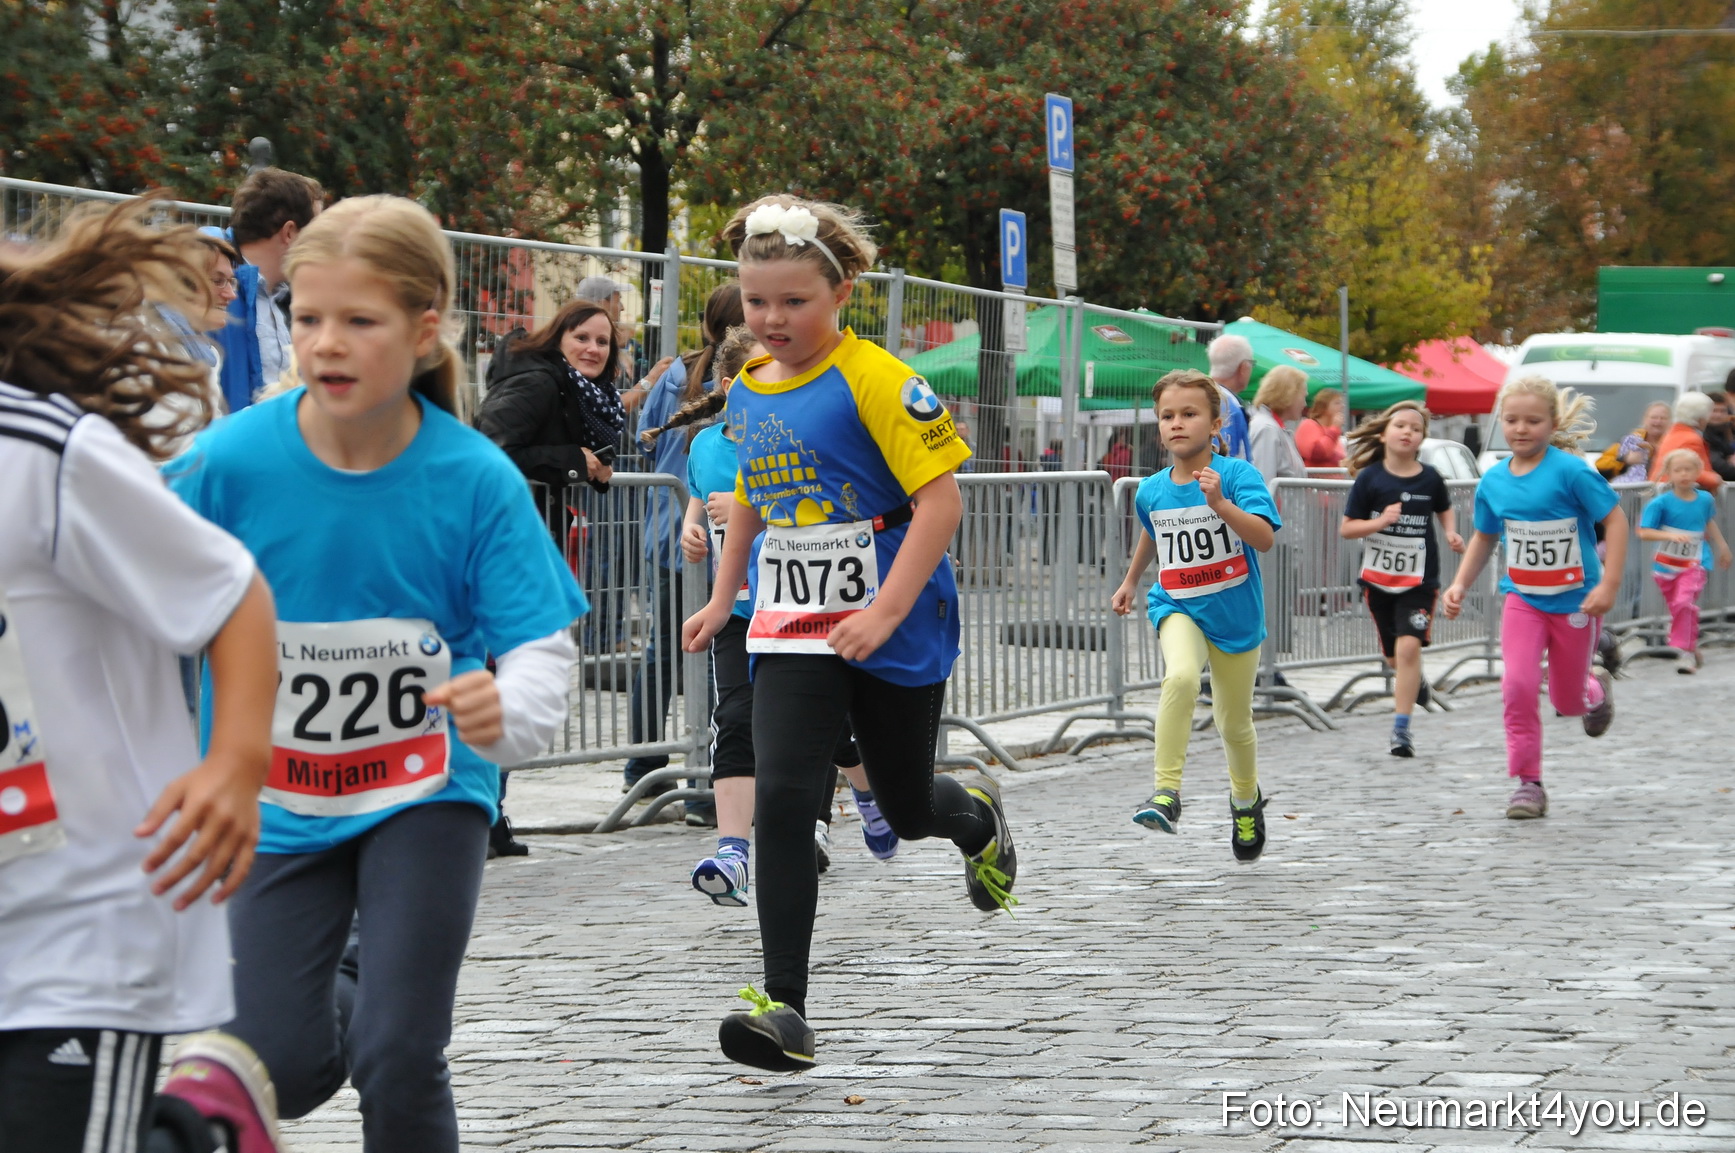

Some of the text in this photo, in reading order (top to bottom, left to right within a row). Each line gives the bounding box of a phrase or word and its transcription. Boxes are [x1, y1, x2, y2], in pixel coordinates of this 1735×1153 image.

[1052, 105, 1068, 159] P
[1006, 221, 1021, 277] P
[920, 418, 953, 445] PART
[1153, 517, 1178, 528] PARTL
[1528, 528, 1567, 536] Neumarkt
[764, 537, 850, 552] ARTL Neumarkt
[1161, 522, 1232, 564] 7091
[1512, 537, 1574, 567] 7557
[1371, 547, 1419, 573] 7561
[765, 556, 866, 606] 7073
[1179, 568, 1223, 586] Sophie
[300, 640, 409, 662] Neumarkt
[278, 665, 427, 742] 226
[286, 757, 388, 795] Mirjam
